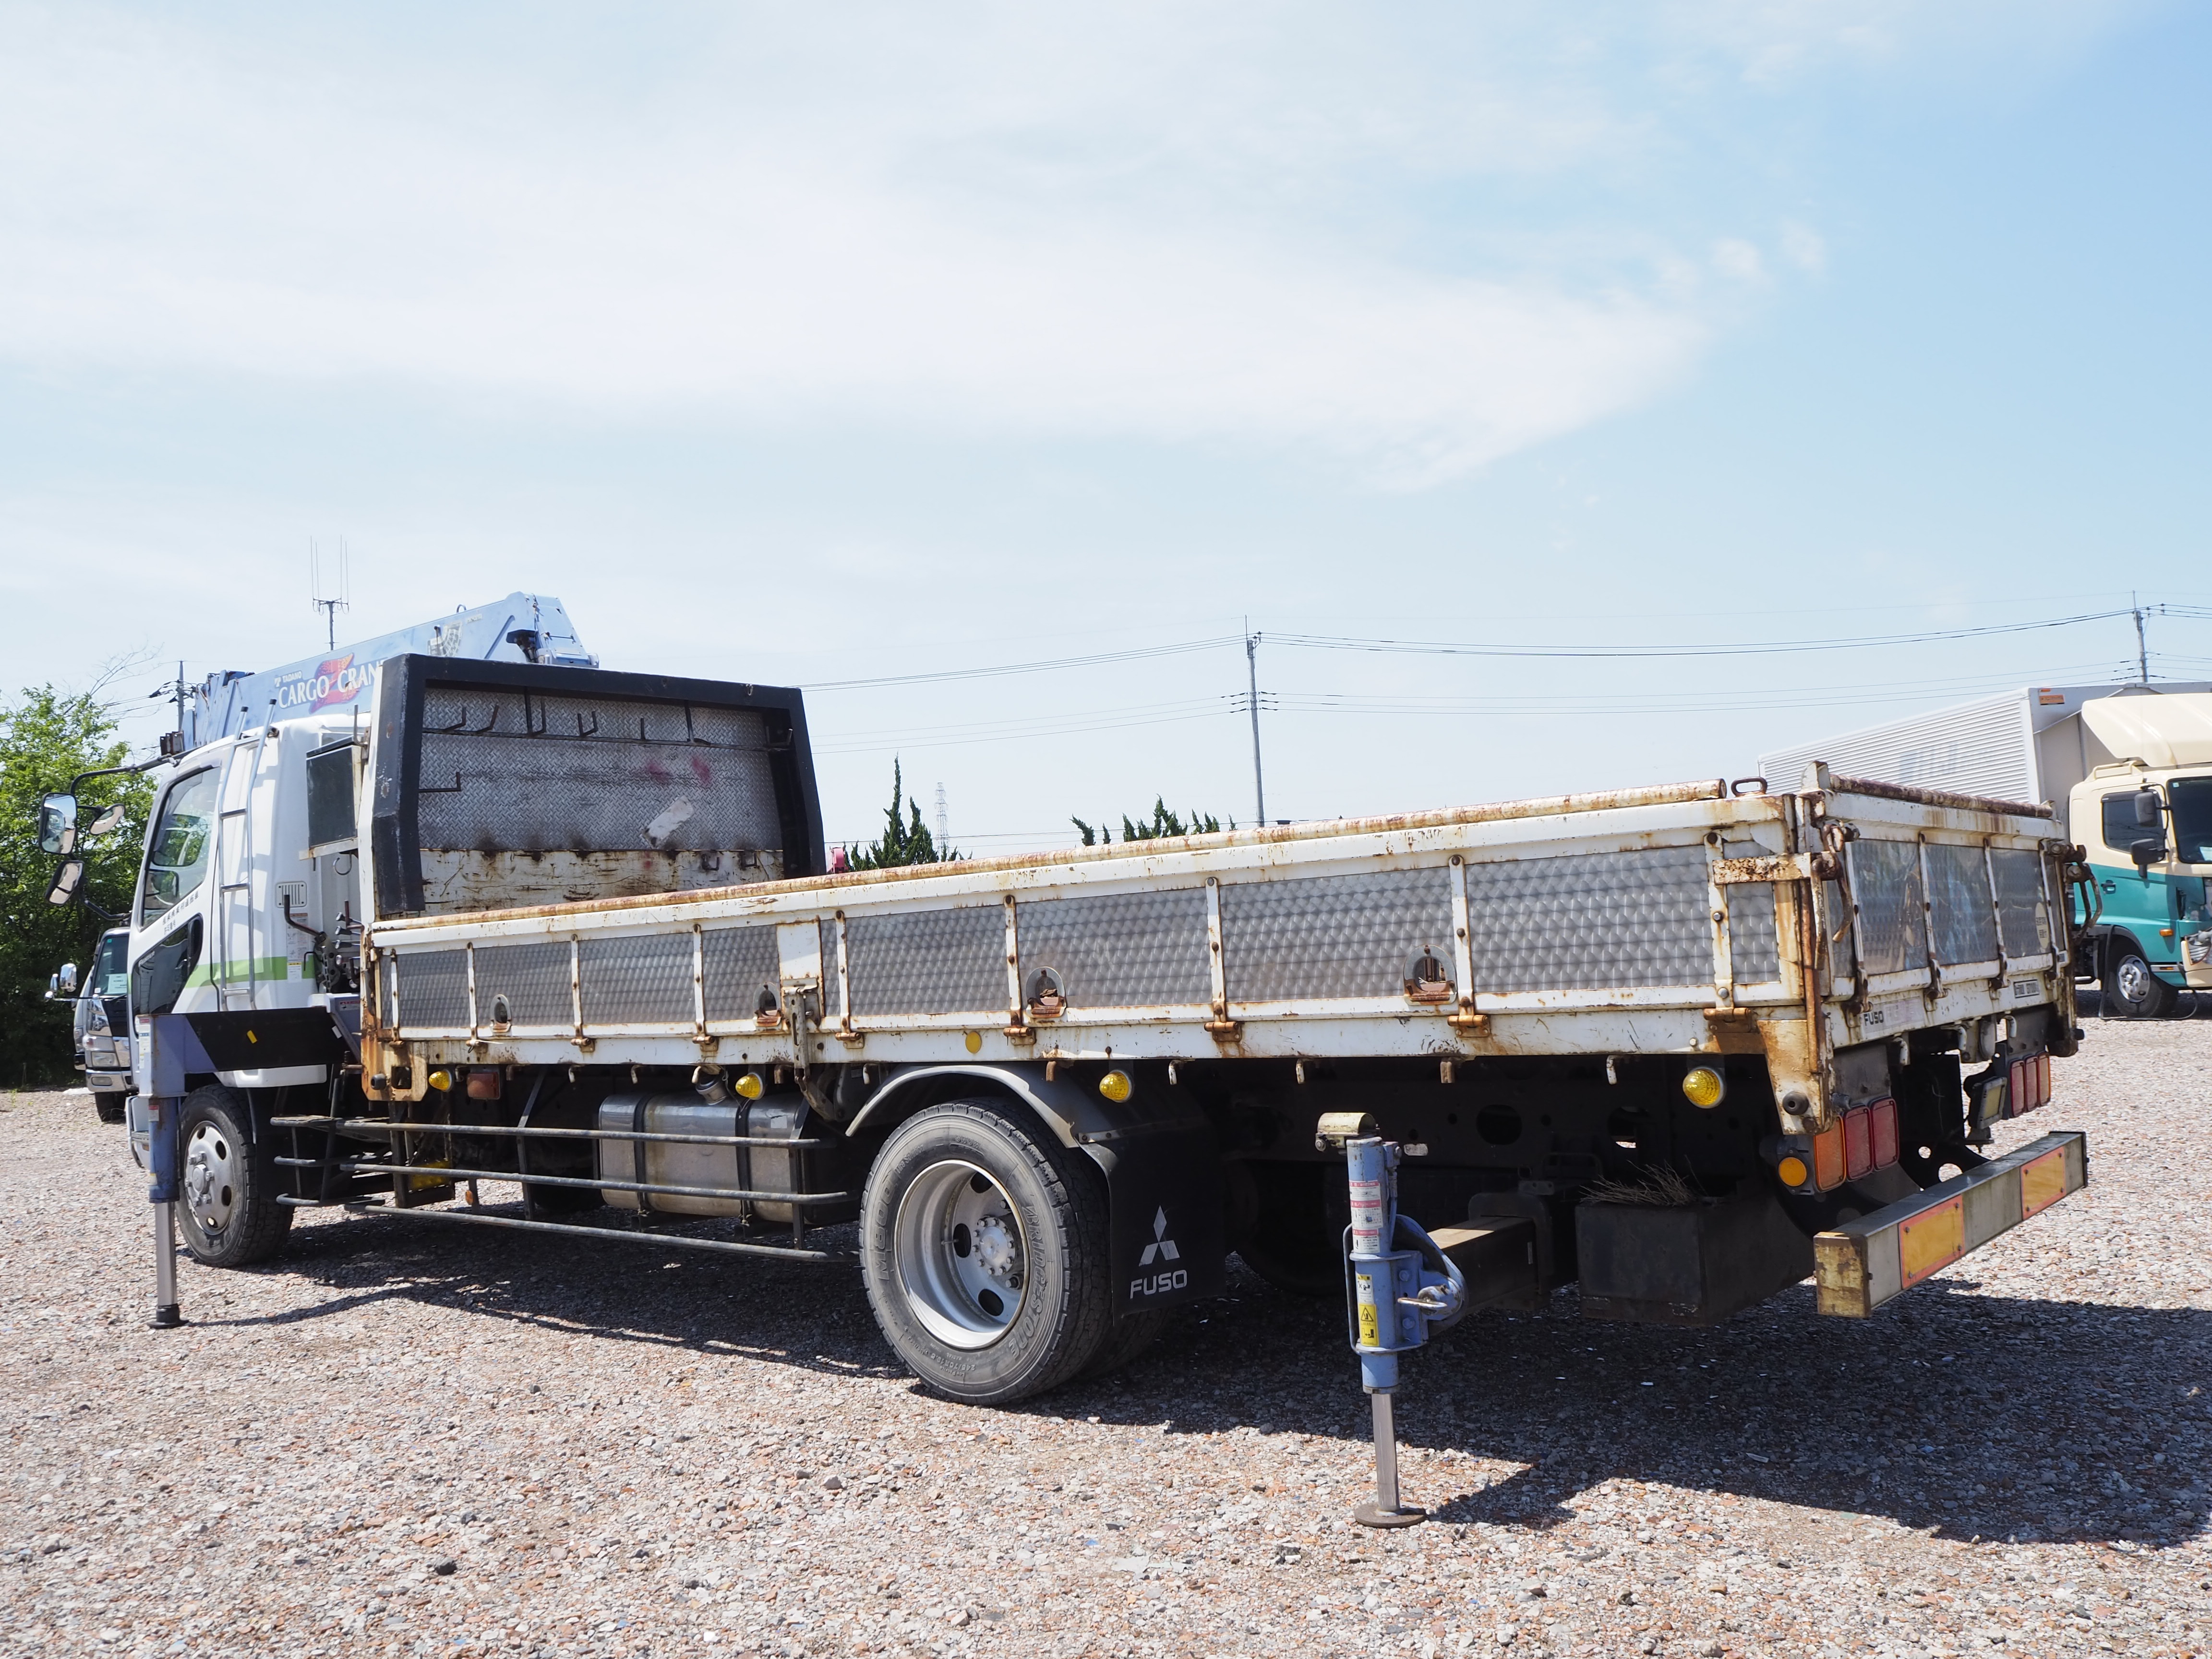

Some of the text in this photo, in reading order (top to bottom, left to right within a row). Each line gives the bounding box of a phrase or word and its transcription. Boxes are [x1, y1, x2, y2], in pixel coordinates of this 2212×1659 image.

[278, 675, 329, 708] CARGO
[337, 660, 385, 692] CRAN
[282, 671, 302, 683] TADANO
[1863, 1010, 1884, 1026] FUSO
[955, 1135, 981, 1148] SNOW
[874, 1178, 895, 1281] M800
[1009, 1205, 1047, 1360] BRIDGESTONE
[1130, 1270, 1188, 1299] FUSO
